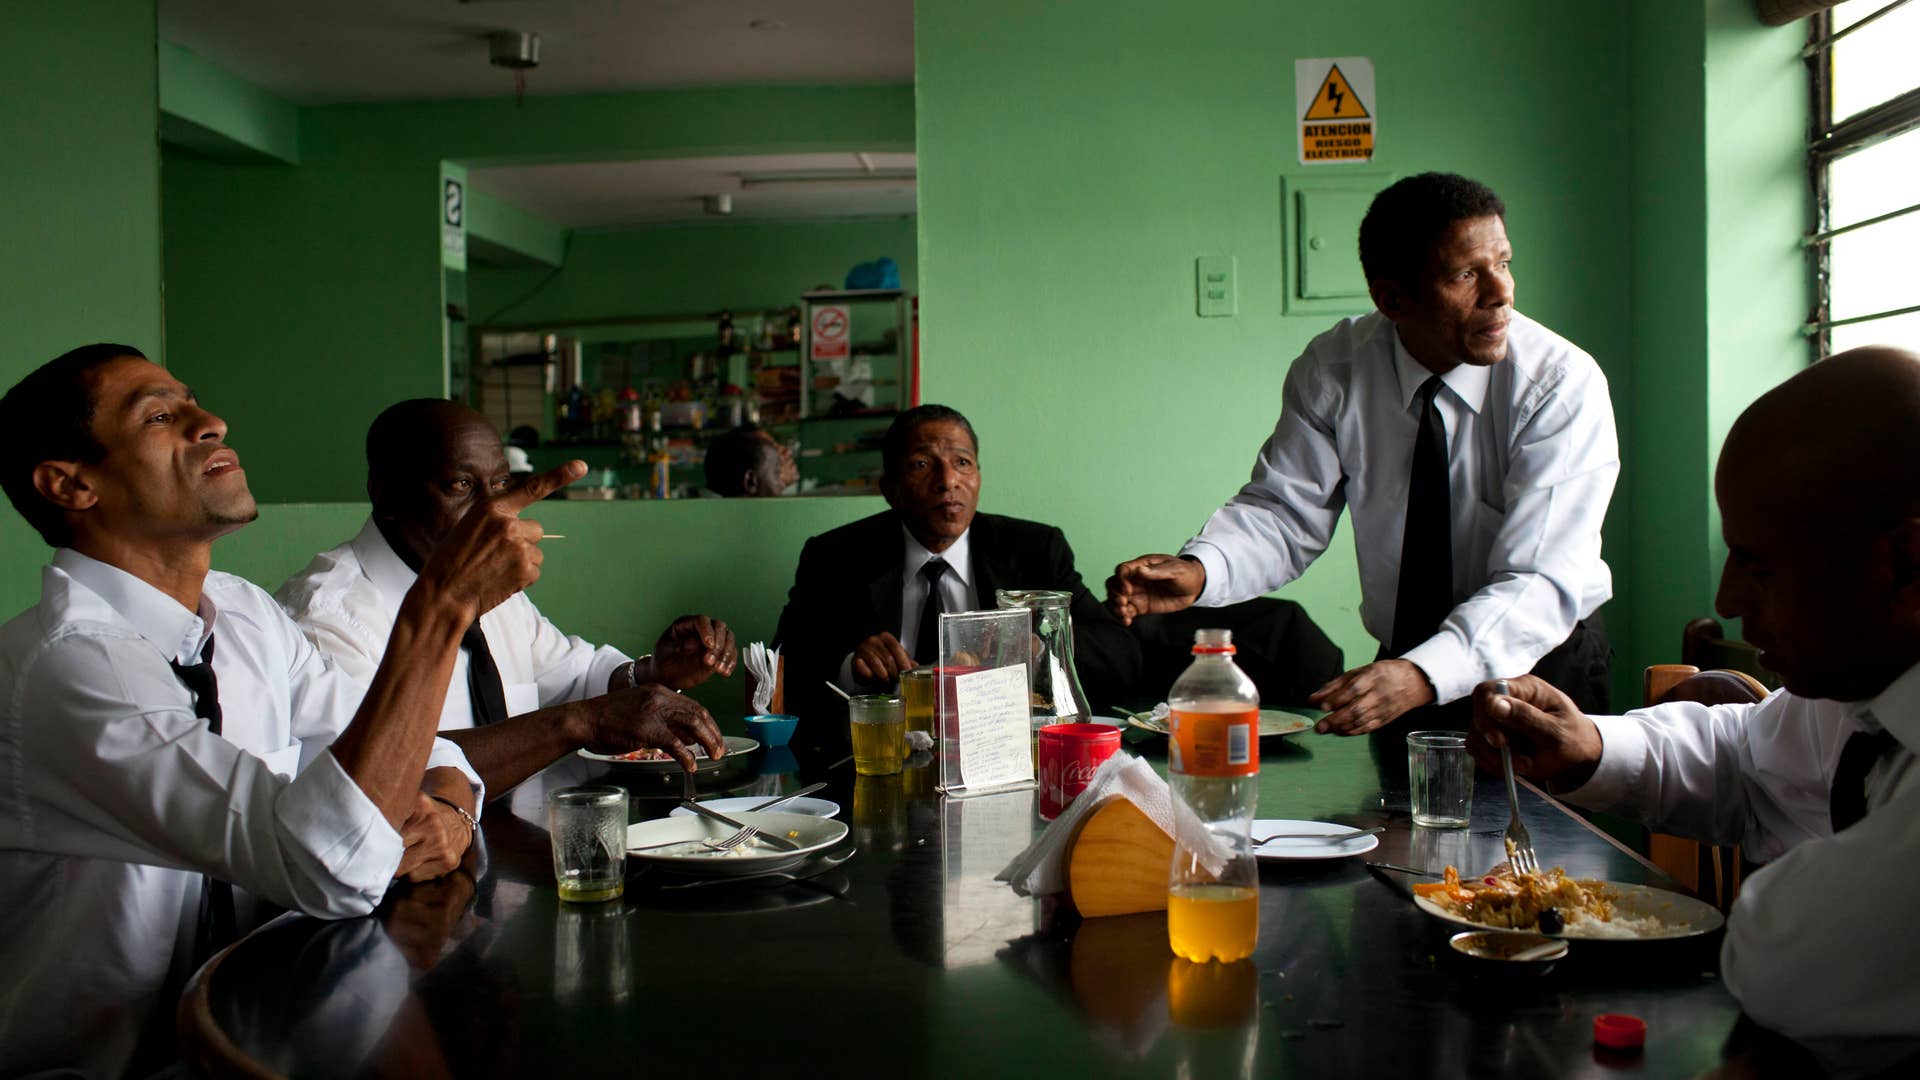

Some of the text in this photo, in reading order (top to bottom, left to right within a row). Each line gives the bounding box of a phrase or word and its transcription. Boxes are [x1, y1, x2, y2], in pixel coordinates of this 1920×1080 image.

[1305, 124, 1371, 137] ATENCION
[1315, 139, 1361, 148] RIESGO
[1305, 149, 1373, 159] ELECTRICO
